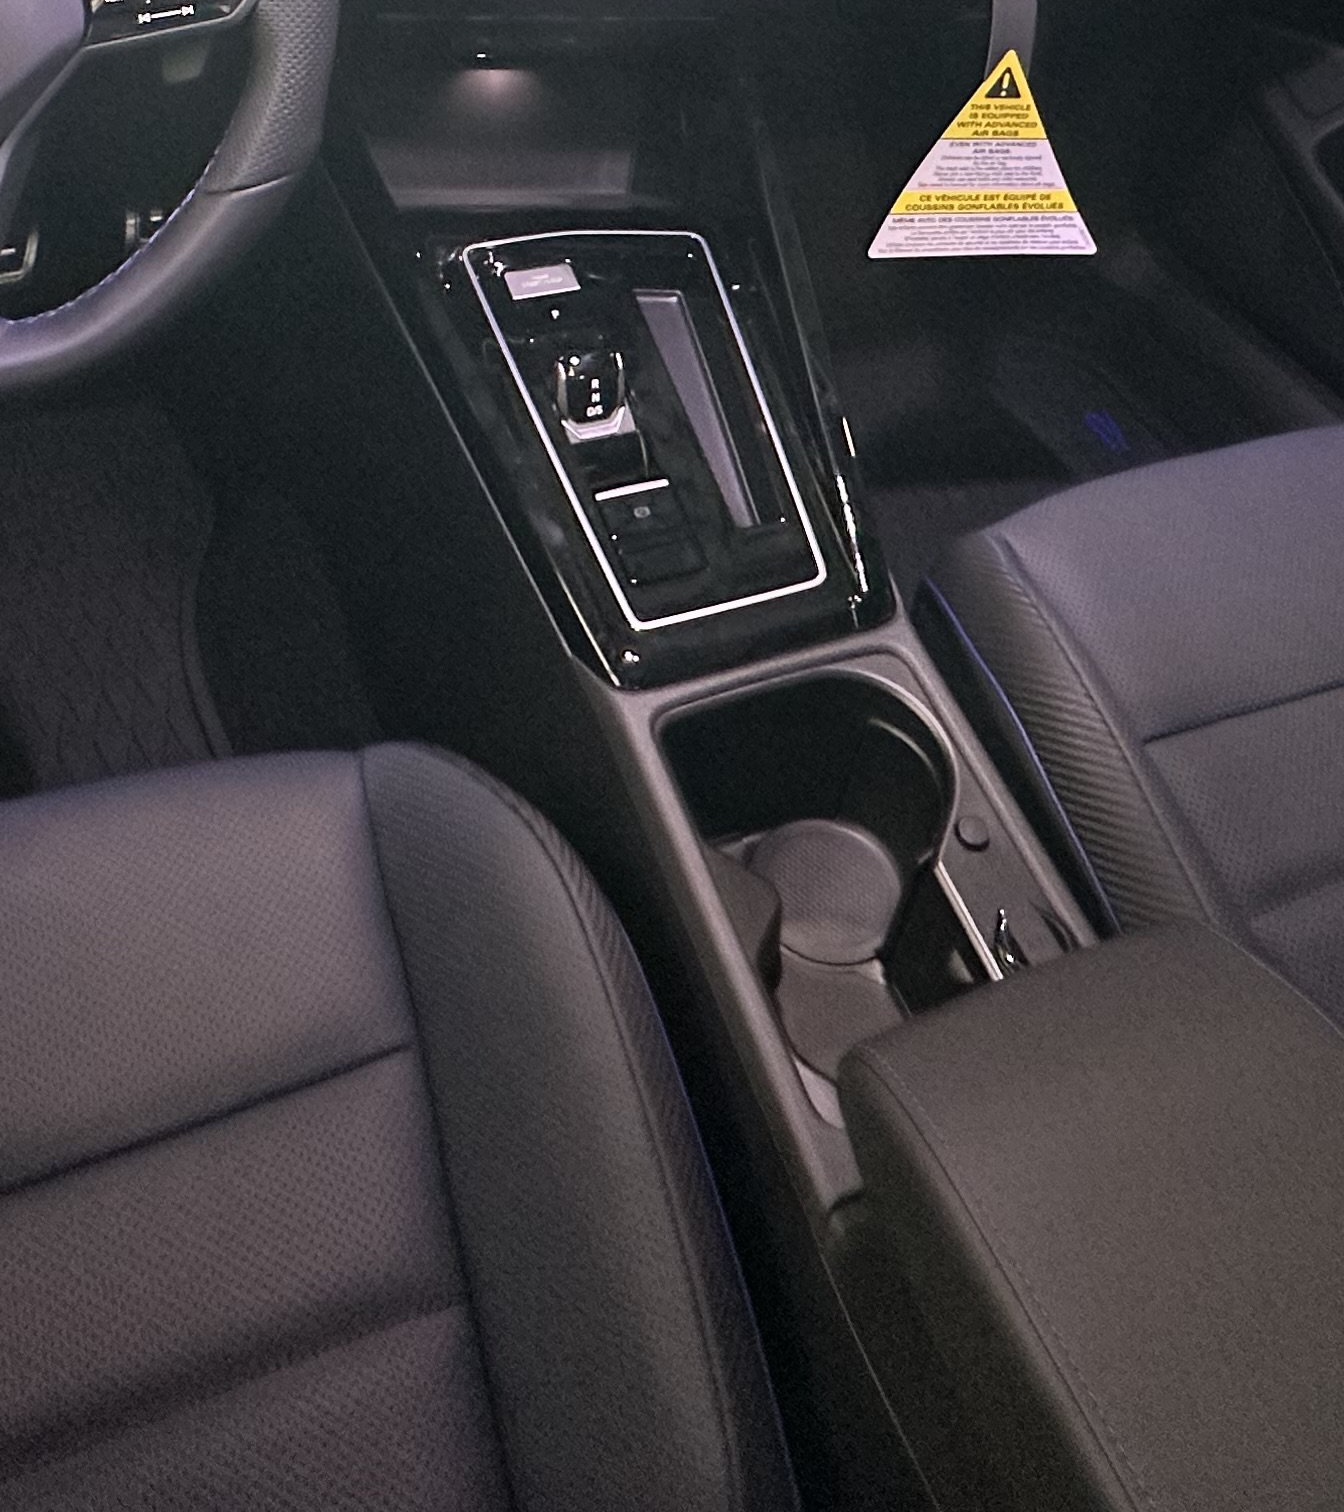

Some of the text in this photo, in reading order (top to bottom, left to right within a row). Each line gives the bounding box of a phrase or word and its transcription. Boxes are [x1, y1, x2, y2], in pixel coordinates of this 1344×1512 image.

[919, 194, 932, 202] CE
[983, 193, 999, 201] EST
[905, 203, 955, 211] COUSSINS
[591, 393, 601, 403] N
